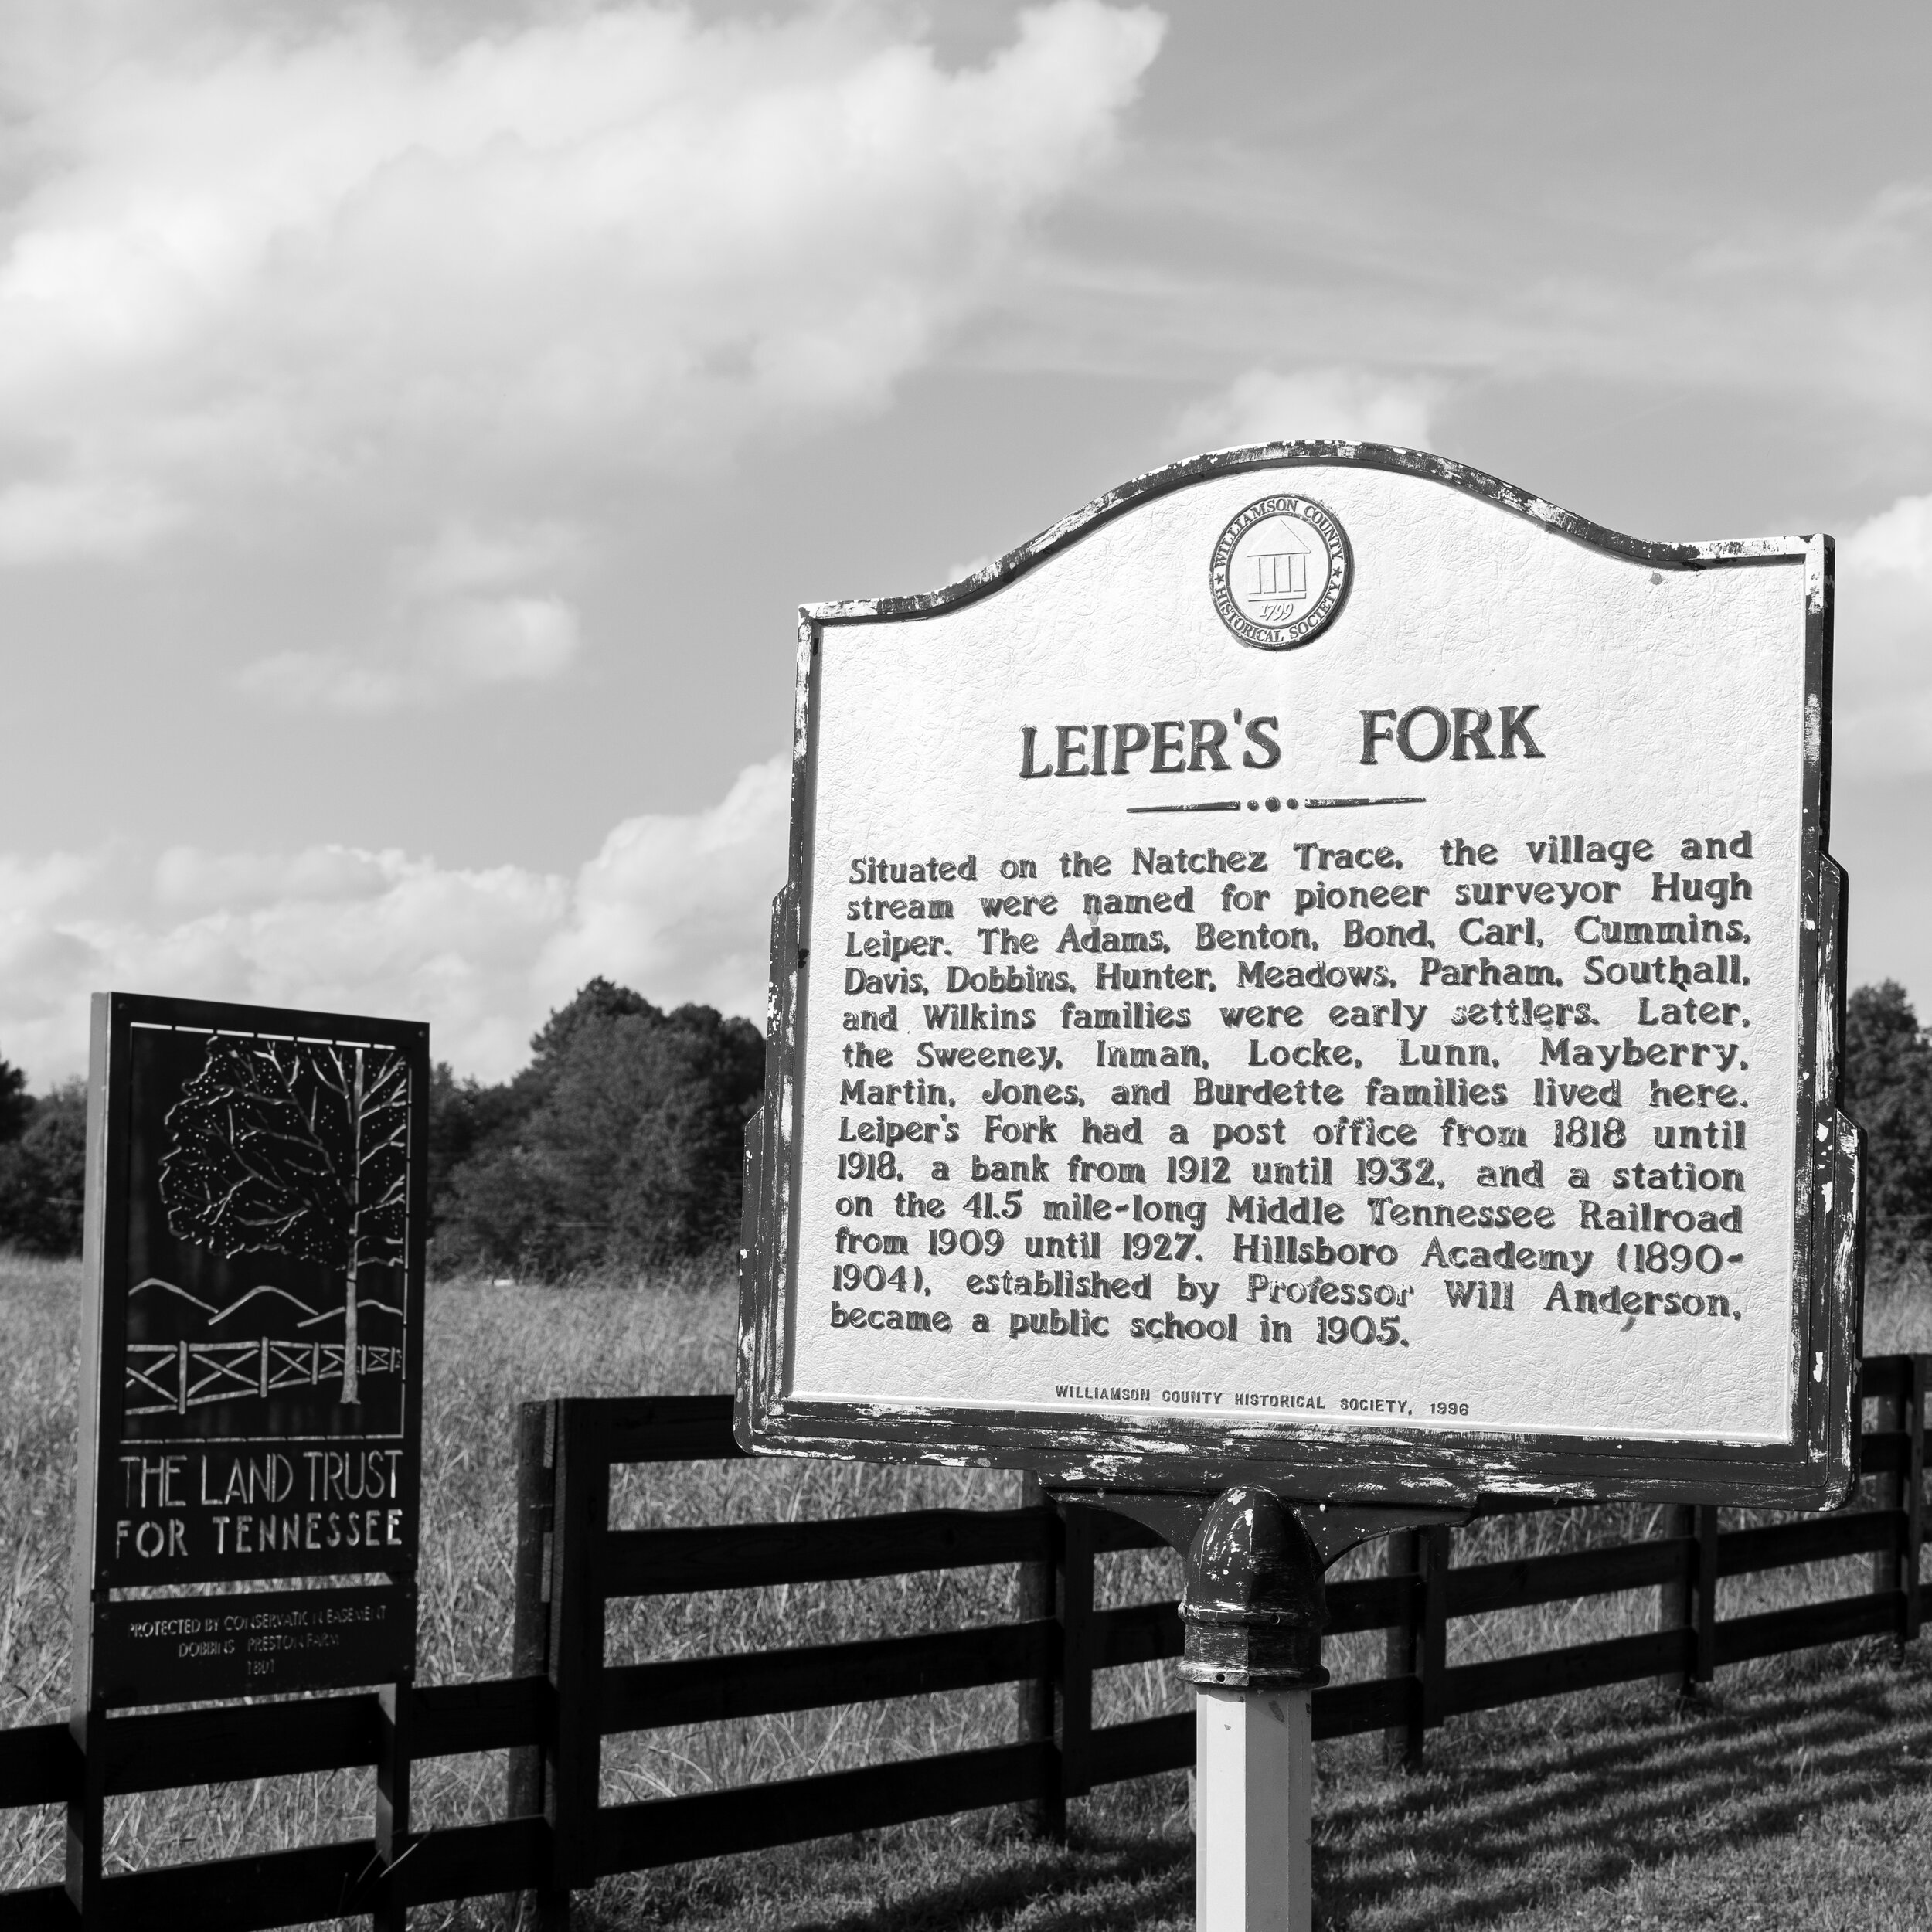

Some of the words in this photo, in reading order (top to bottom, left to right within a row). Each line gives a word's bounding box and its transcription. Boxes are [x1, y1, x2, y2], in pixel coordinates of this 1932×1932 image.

[1214, 498, 1298, 569] WILLIAMSON
[1304, 505, 1343, 560] COUNTY
[1216, 586, 1284, 642] HISTORICAL
[1289, 580, 1340, 639] SOCIETY
[1260, 602, 1294, 621] 1799
[1019, 709, 1280, 778] LEIPER'S
[1359, 706, 1545, 764] FORK
[849, 855, 977, 884] Situated
[1000, 860, 1037, 879] on
[1059, 851, 1111, 877] the
[1132, 848, 1267, 875] Natchez
[1294, 842, 1403, 870] Trace,
[1440, 838, 1498, 866] the
[1526, 835, 1653, 871] village
[1681, 831, 1753, 860] and
[847, 896, 954, 920] stream
[981, 895, 1057, 917] were
[1083, 886, 1194, 915] named
[1222, 883, 1270, 911] for
[1294, 881, 1429, 916] pioneer
[1455, 882, 1621, 909] surveyor
[1651, 872, 1751, 910] Hugh
[845, 930, 951, 962] Leiper.
[978, 927, 1038, 954] The
[1056, 924, 1170, 953] Adams,
[1196, 923, 1318, 951] Benton,
[1343, 920, 1435, 948] Bond,
[1460, 917, 1543, 947] Carl,
[1575, 913, 1750, 944] Cummins,
[845, 968, 928, 995] Davis,
[947, 965, 1076, 993] Dobbins,
[1096, 963, 1216, 992] Hunter,
[1238, 961, 1396, 988] Meadows,
[1420, 957, 1563, 987] Parham,
[1584, 954, 1750, 986] Southall,
[843, 1005, 897, 1031] and
[923, 1003, 1035, 1030] Wilkins
[1062, 1001, 1191, 1029] families
[1219, 1006, 1303, 1028] were
[1329, 998, 1427, 1031] early
[1451, 997, 1600, 1026] settlers.
[1638, 997, 1750, 1027] Later,
[842, 1041, 893, 1067] the
[917, 1042, 1063, 1071] Sweeney,
[1097, 1040, 1209, 1070] Inman,
[1248, 1038, 1362, 1068] Locke,
[1399, 1039, 1499, 1068] Lunn,
[1539, 1037, 1748, 1072] Mayberry,
[840, 1078, 955, 1107] Martin,
[982, 1079, 1084, 1107] Jones,
[1111, 1080, 1170, 1105] and
[1193, 1077, 1344, 1106] Burdette
[1365, 1077, 1507, 1107] families
[1533, 1077, 1621, 1107] lived
[1649, 1079, 1748, 1107] here.
[839, 1114, 959, 1148] Leiper's
[985, 1115, 1057, 1143] Fork
[1082, 1117, 1143, 1144] had
[1169, 1124, 1189, 1144] a
[1213, 1118, 1286, 1149] post
[1313, 1116, 1417, 1146] office
[1440, 1117, 1527, 1147] from
[1553, 1116, 1626, 1148] 1818
[1653, 1120, 1746, 1150] until
[838, 1151, 903, 1182] 1918,
[932, 1162, 950, 1180] a
[971, 1154, 1049, 1182] bank
[1067, 1155, 1146, 1184] from
[1167, 1156, 1230, 1183] 1912
[1253, 1156, 1332, 1185] until
[1356, 1157, 1444, 1189] 1932,
[1477, 1160, 1544, 1189] and
[1568, 1168, 1590, 1189] a
[1613, 1162, 1744, 1192] station
[836, 1196, 873, 1216] on
[893, 1192, 945, 1218] the
[963, 1189, 1022, 1219] 41.5
[1043, 1193, 1207, 1230] mile-long
[1226, 1195, 1344, 1225] Middle
[1368, 1196, 1555, 1229] Tennessee
[1580, 1200, 1743, 1233] Railroad
[835, 1226, 909, 1254] from
[928, 1229, 1004, 1256] 1909
[1025, 1232, 1100, 1259] until
[1122, 1232, 1202, 1261] 1927.
[1233, 1233, 1398, 1266] Hillsboro
[1421, 1236, 1594, 1277] Academy
[1617, 1241, 1743, 1274] (1890-
[832, 1264, 930, 1296] 1904),
[967, 1270, 1151, 1300] established
[1178, 1274, 1220, 1309] by
[1247, 1274, 1413, 1307] Professor
[1444, 1280, 1514, 1311] Will
[1543, 1281, 1743, 1321] Anderson,
[831, 1301, 951, 1332] became
[972, 1314, 989, 1332] a
[1009, 1308, 1109, 1339] public
[1131, 1311, 1237, 1341] school
[1260, 1314, 1292, 1342] in
[1317, 1315, 1409, 1347] 1905.
[1056, 1386, 1149, 1400] WILLIAMSON
[1162, 1390, 1222, 1404] COUNTY
[1236, 1393, 1325, 1409] HISTORICAL
[1341, 1398, 1413, 1416] SOCIETY,
[1430, 1403, 1468, 1415] 1996
[119, 1455, 188, 1508] THE
[201, 1453, 294, 1505] LAND
[303, 1450, 404, 1502] TRUST
[116, 1519, 189, 1559] FOR
[212, 1509, 403, 1555] TENNESSEE
[128, 1618, 201, 1638] PROTECTED
[205, 1617, 219, 1632] BY
[178, 1639, 235, 1658] DOBBINS
[247, 1634, 304, 1652] PRESTON
[307, 1633, 339, 1648] FARM
